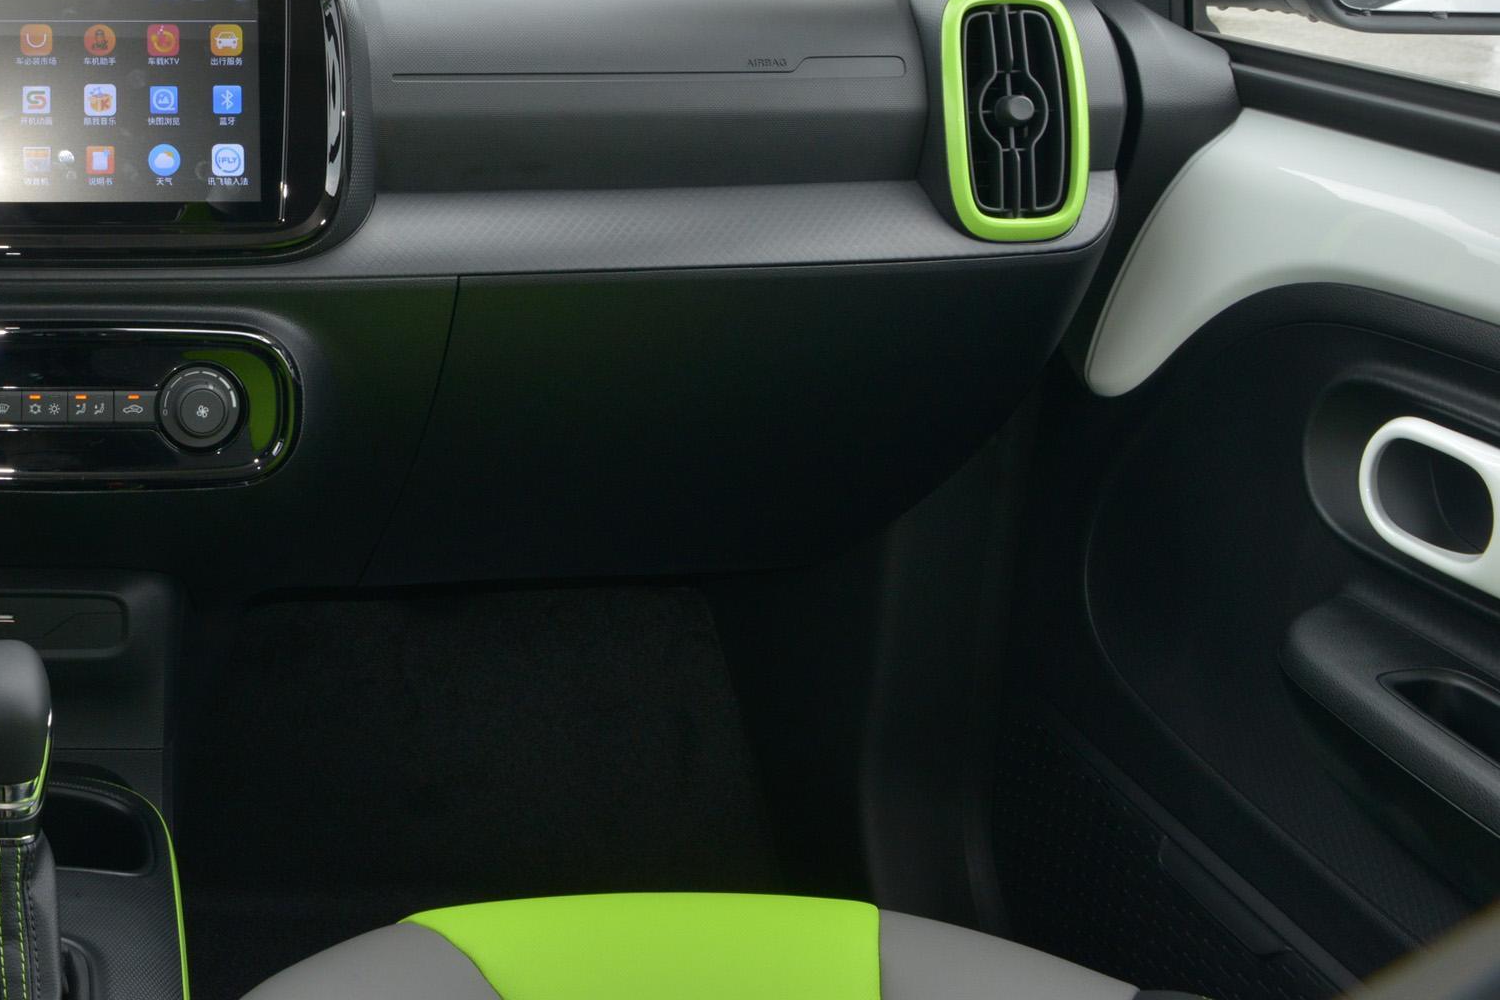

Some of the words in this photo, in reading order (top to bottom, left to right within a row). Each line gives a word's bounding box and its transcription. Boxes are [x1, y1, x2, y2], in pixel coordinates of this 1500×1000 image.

[148, 57, 180, 67] 车载KTV
[210, 57, 243, 67] 出行服务
[747, 57, 788, 68] AIRBAG
[219, 117, 236, 126] 蓝牙
[156, 177, 173, 186] 天气
